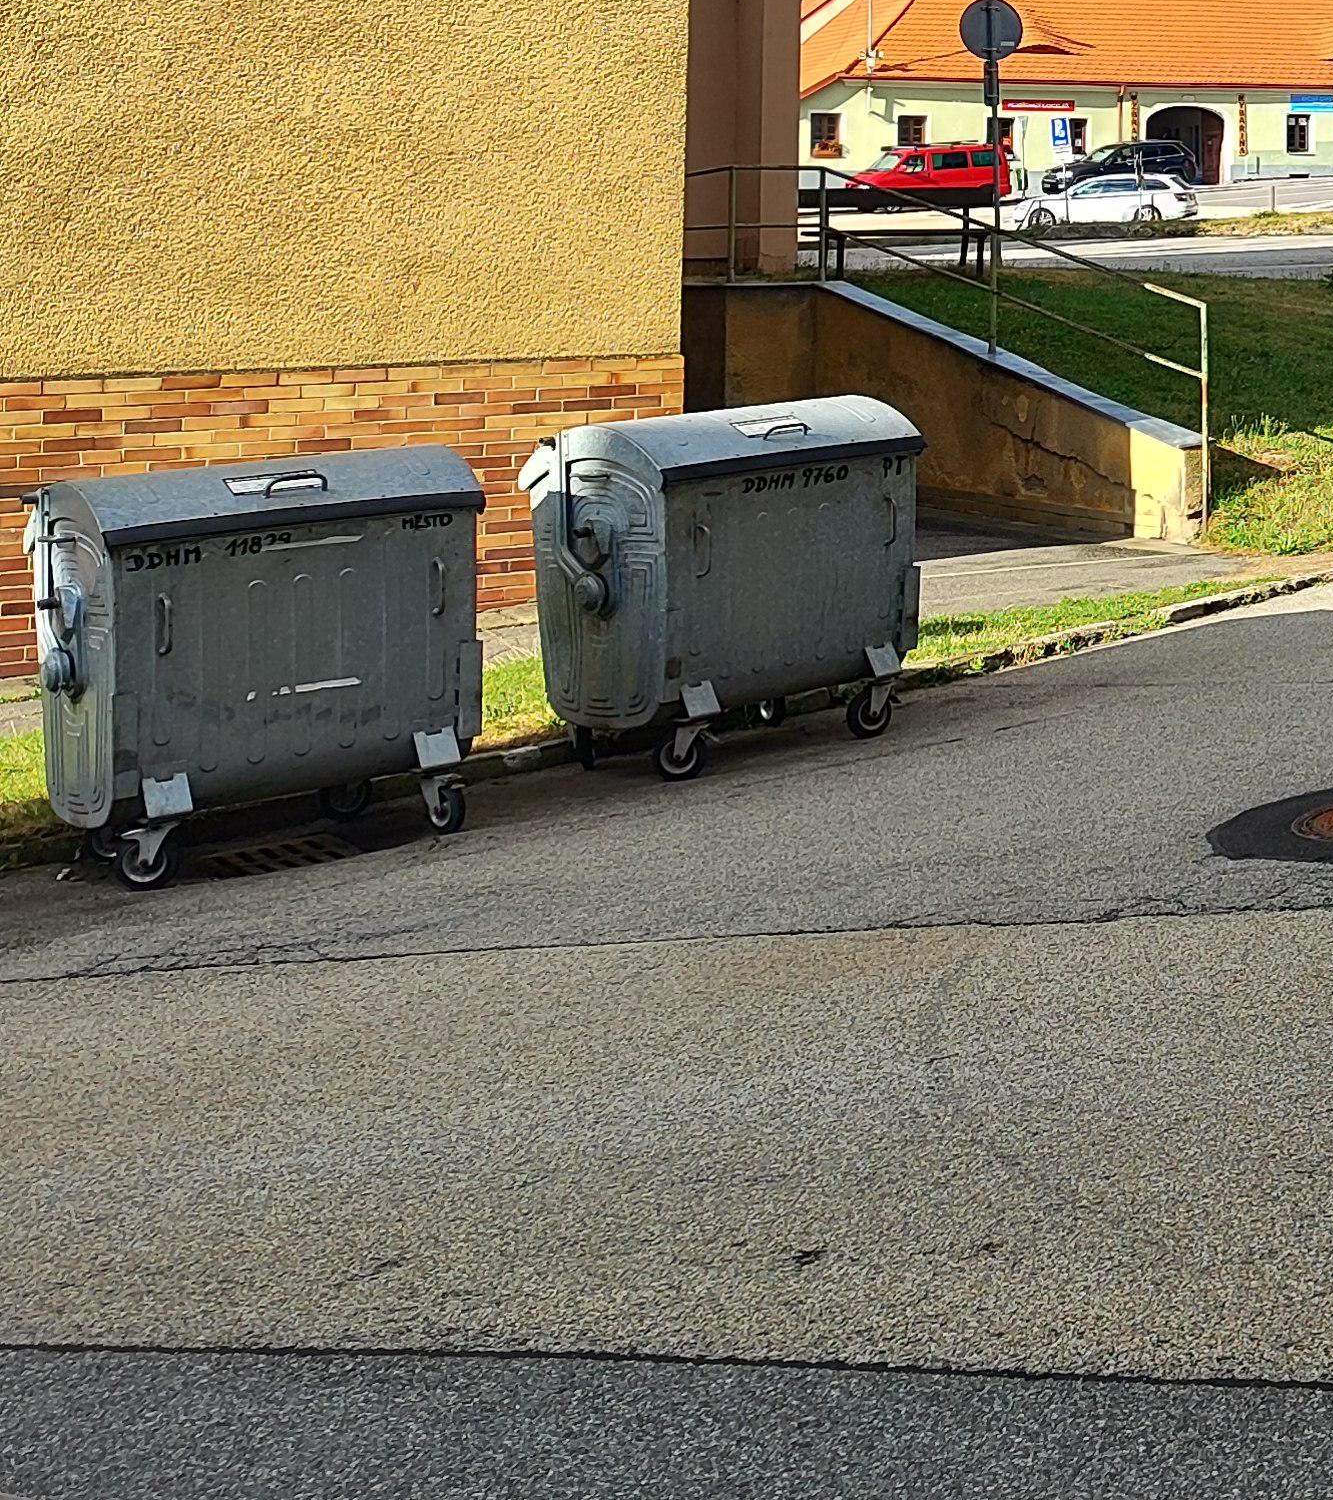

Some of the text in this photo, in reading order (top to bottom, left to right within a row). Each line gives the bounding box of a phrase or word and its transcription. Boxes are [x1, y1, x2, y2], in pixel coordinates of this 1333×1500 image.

[741, 465, 849, 494] DDHM 9760
[882, 455, 908, 478] PT
[125, 546, 201, 572] DDHM
